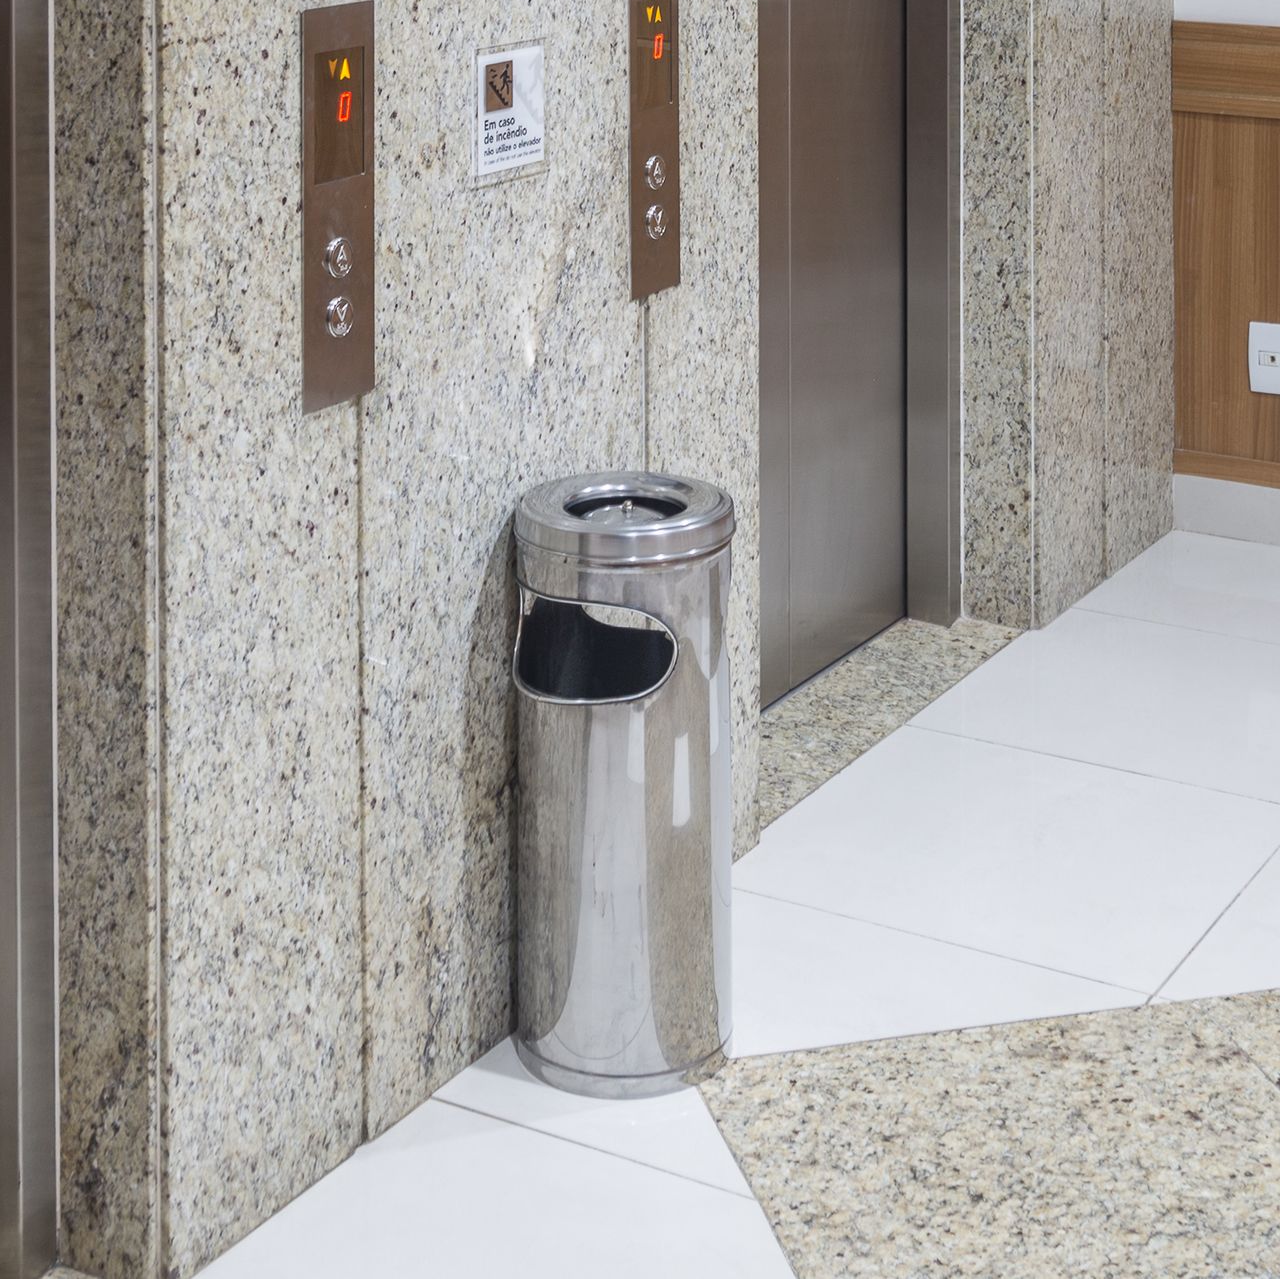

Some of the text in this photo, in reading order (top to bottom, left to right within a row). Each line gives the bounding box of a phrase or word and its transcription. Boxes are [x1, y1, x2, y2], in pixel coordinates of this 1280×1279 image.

[653, 32, 664, 60] 0
[338, 91, 352, 122] 0
[484, 117, 515, 131] Em caso
[484, 125, 527, 144] de incêndio
[484, 147, 495, 157] não
[496, 144, 512, 154] utilize
[518, 137, 542, 148] elevador
